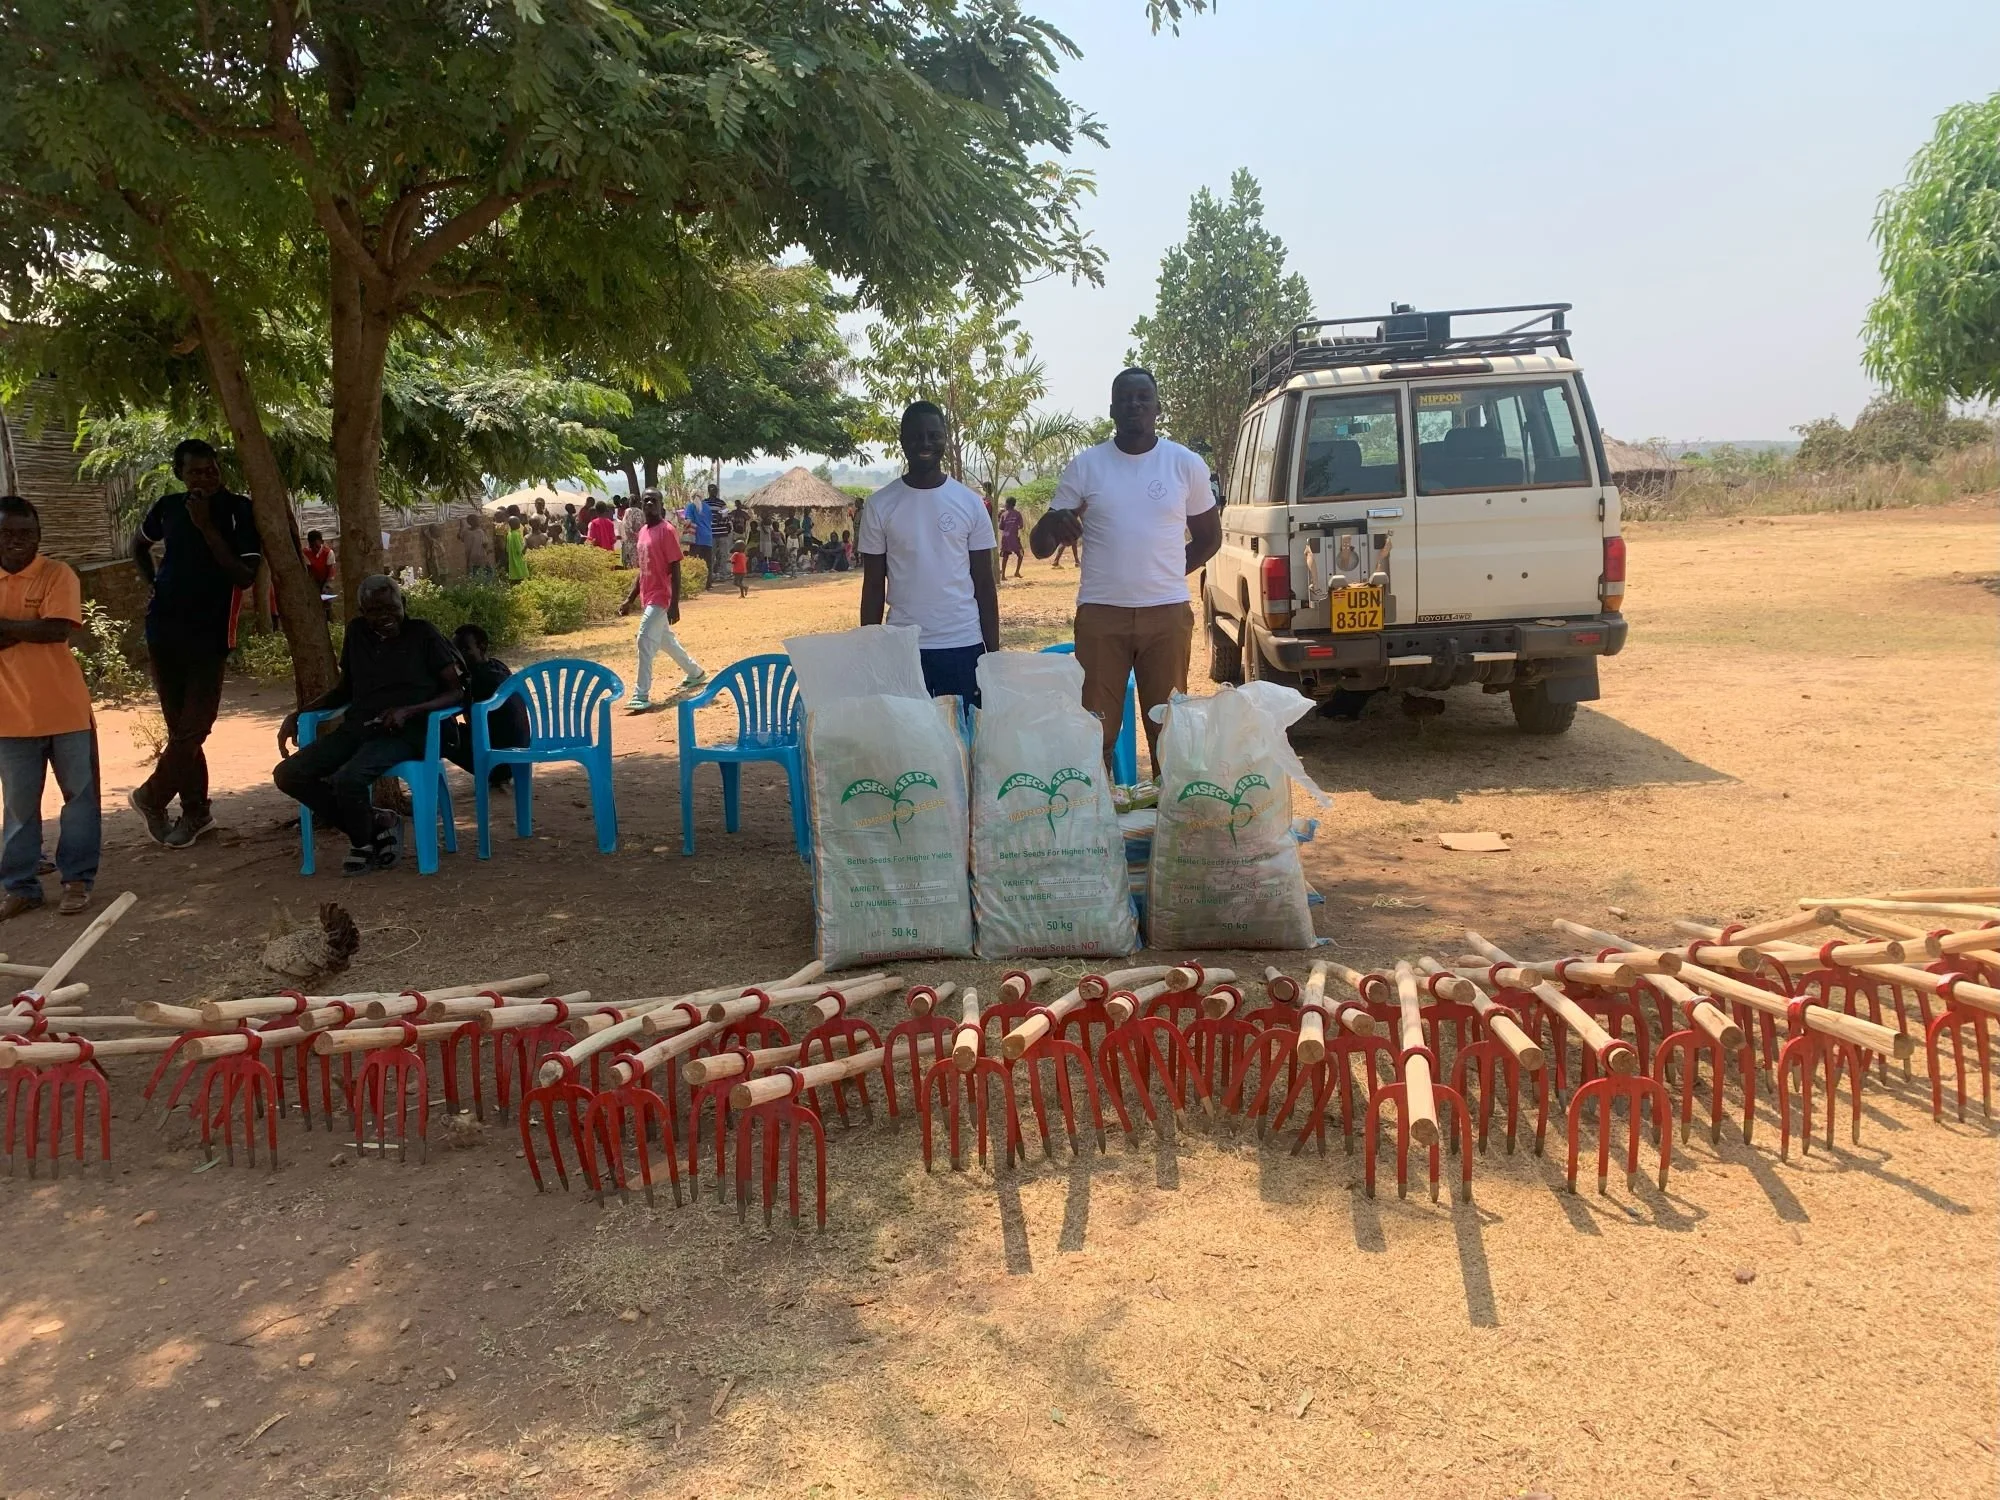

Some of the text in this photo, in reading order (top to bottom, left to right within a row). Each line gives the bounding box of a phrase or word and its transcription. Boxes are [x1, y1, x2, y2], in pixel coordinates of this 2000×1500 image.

[1419, 393, 1461, 404] NIPPON
[1347, 591, 1380, 609] UBN
[1336, 610, 1379, 629] 830Z
[848, 772, 933, 796] NASECO SEEDS
[1005, 768, 1087, 791] NASECO SEEDS
[1186, 775, 1267, 801] NASECO SEEDS
[1008, 802, 1065, 823] IMPROVED
[847, 857, 867, 865] Better
[869, 855, 891, 864] Seeds
[906, 853, 930, 862] Higher
[931, 851, 953, 860] Yields
[999, 846, 1107, 860] Better Seeds For Higher Yields
[849, 885, 881, 894] VARIETY
[1002, 879, 1035, 888] VARIETY
[1003, 892, 1052, 902] LOT NUMBER
[850, 899, 897, 908] LOT NUMBER
[1046, 921, 1058, 931] 50
[1061, 920, 1073, 932] kg
[1221, 921, 1249, 931] 50 kg
[891, 927, 903, 937] 50
[906, 927, 918, 938] kg
[926, 947, 945, 956] NOT
[1015, 941, 1100, 954] Treated Seeds NOT
